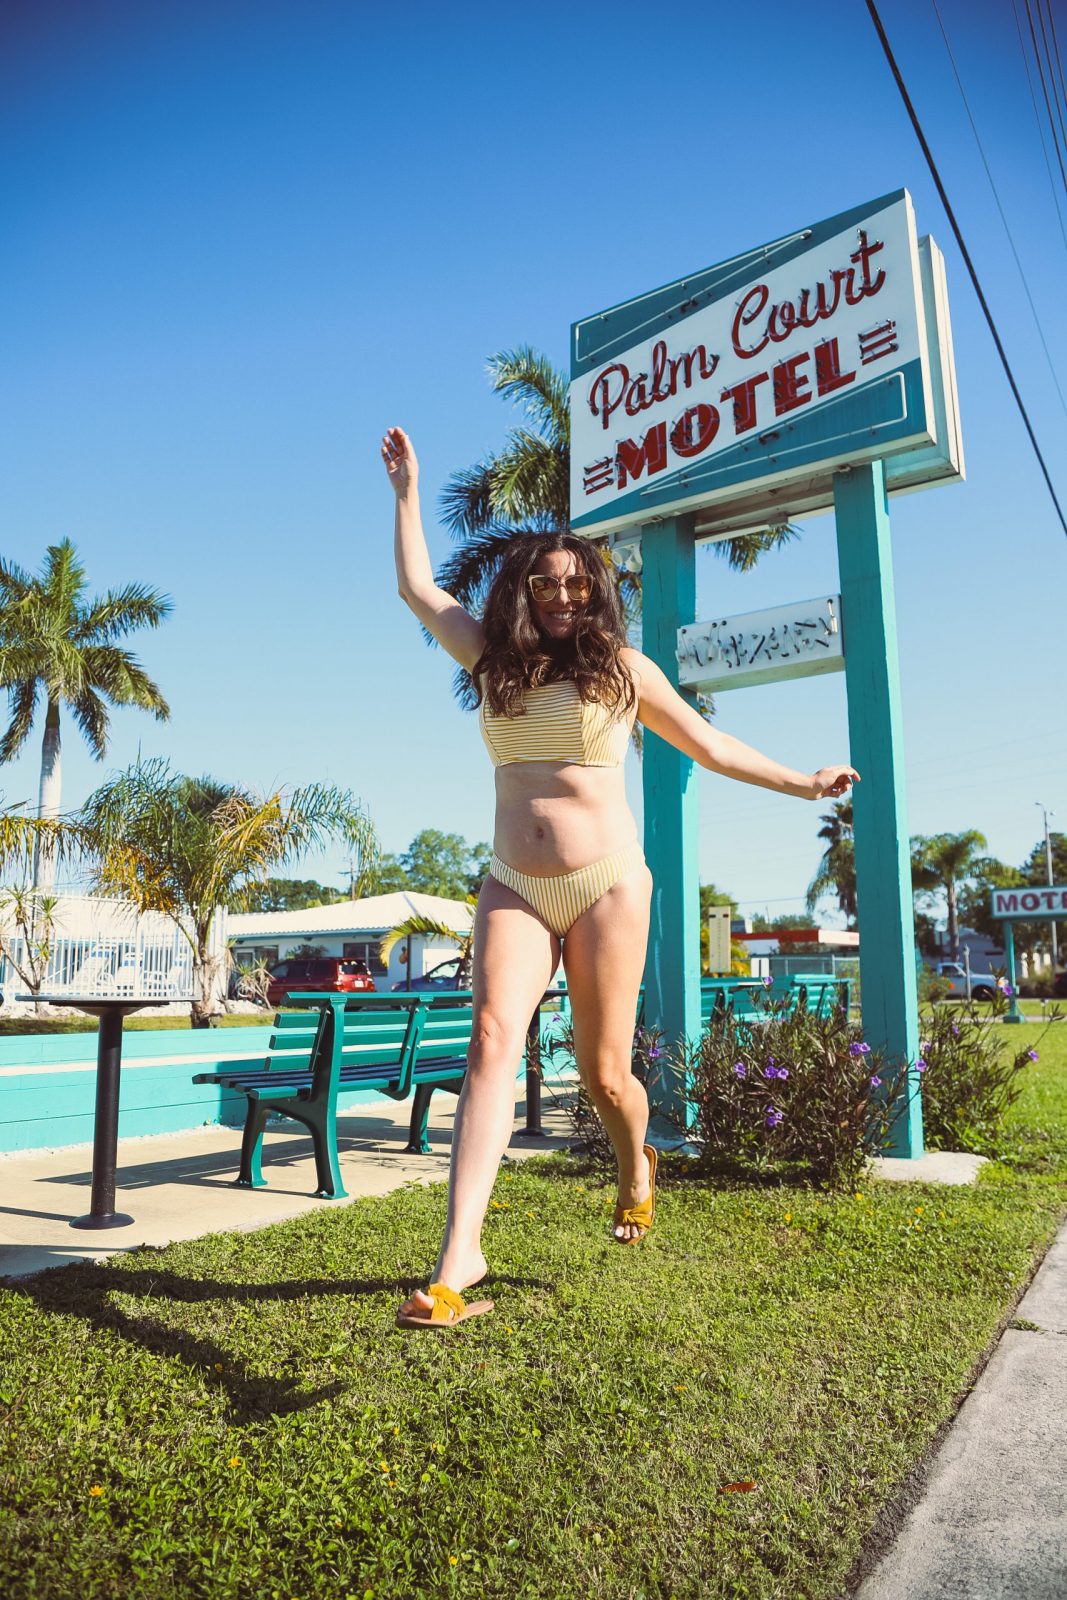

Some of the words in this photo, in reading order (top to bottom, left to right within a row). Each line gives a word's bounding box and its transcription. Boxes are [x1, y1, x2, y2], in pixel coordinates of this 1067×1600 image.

[589, 340, 720, 430] Palm
[731, 229, 886, 359] Court
[616, 337, 857, 490] MOTEL
